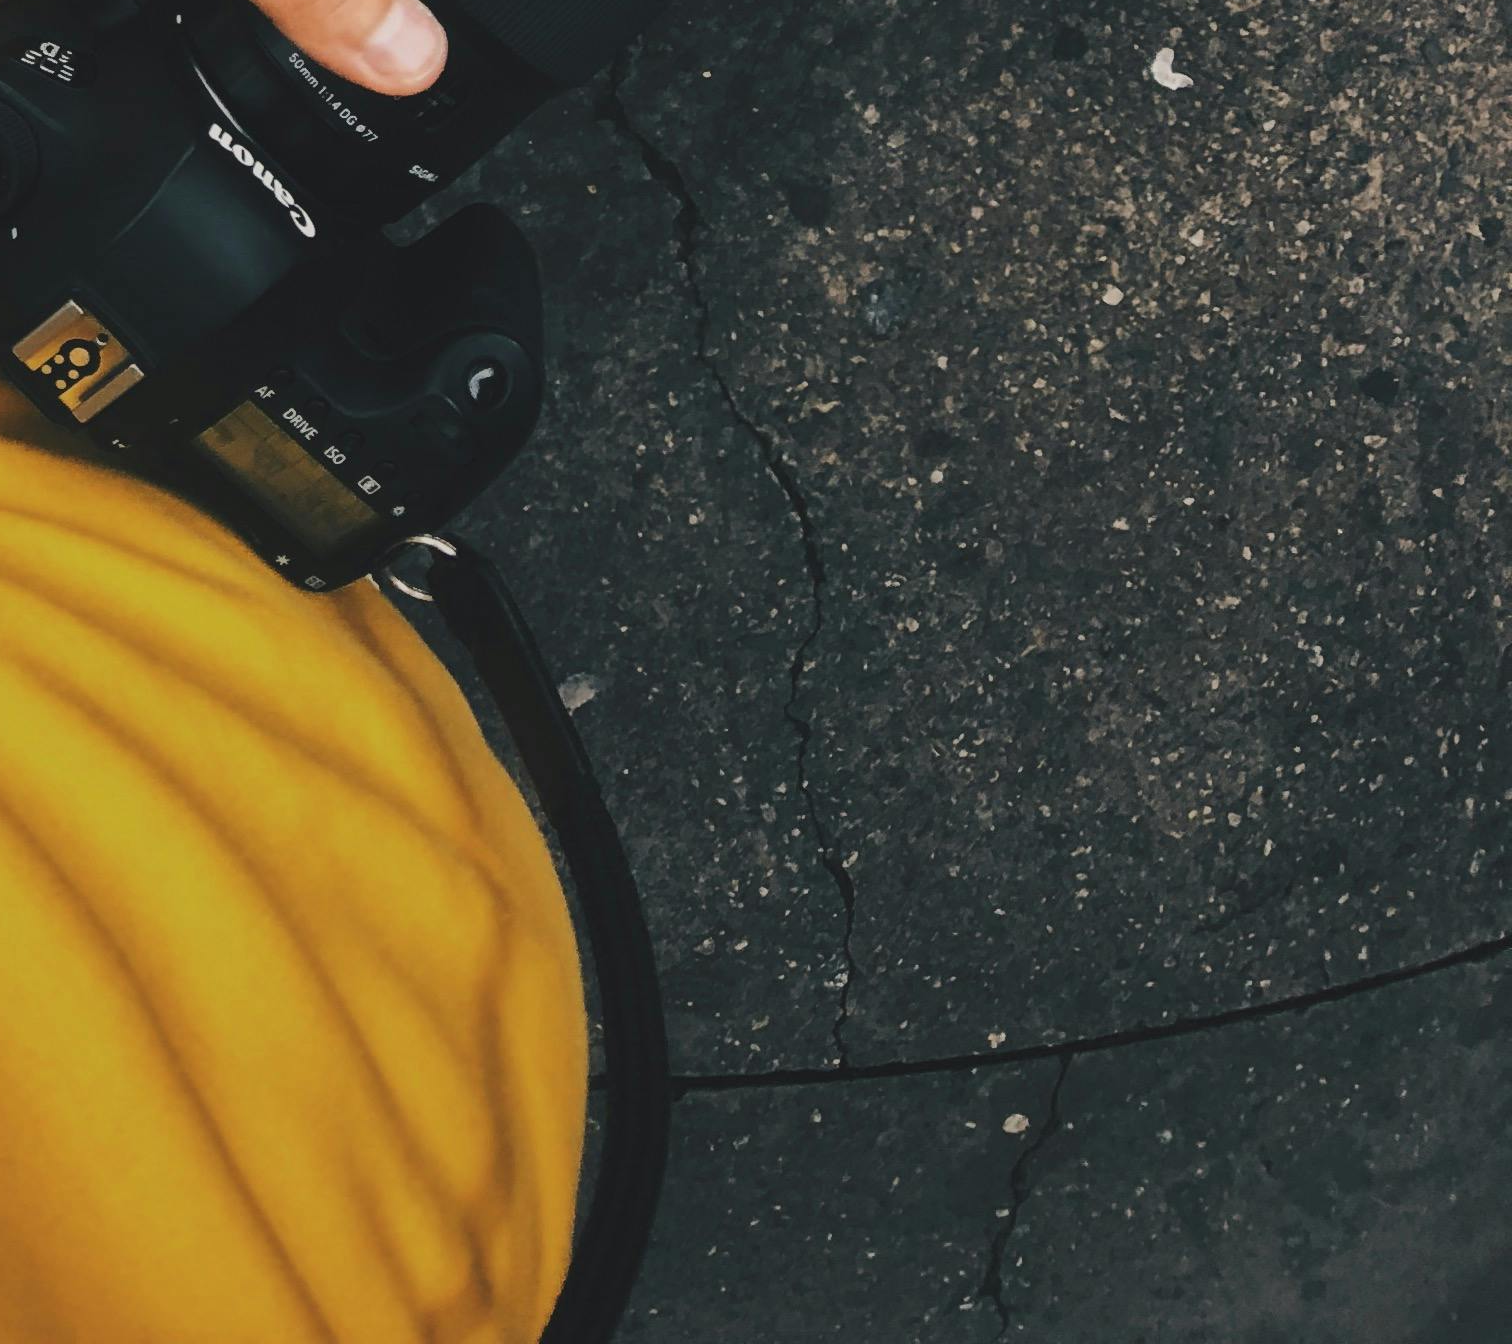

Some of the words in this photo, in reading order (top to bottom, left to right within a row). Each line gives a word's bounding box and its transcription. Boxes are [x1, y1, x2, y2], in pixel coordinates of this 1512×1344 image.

[288, 52, 319, 88] 50mm
[339, 108, 358, 126] DG
[208, 123, 316, 238] Canon
[254, 385, 276, 399] AF
[282, 407, 319, 441] DRIVE
[323, 445, 347, 465] ISO
